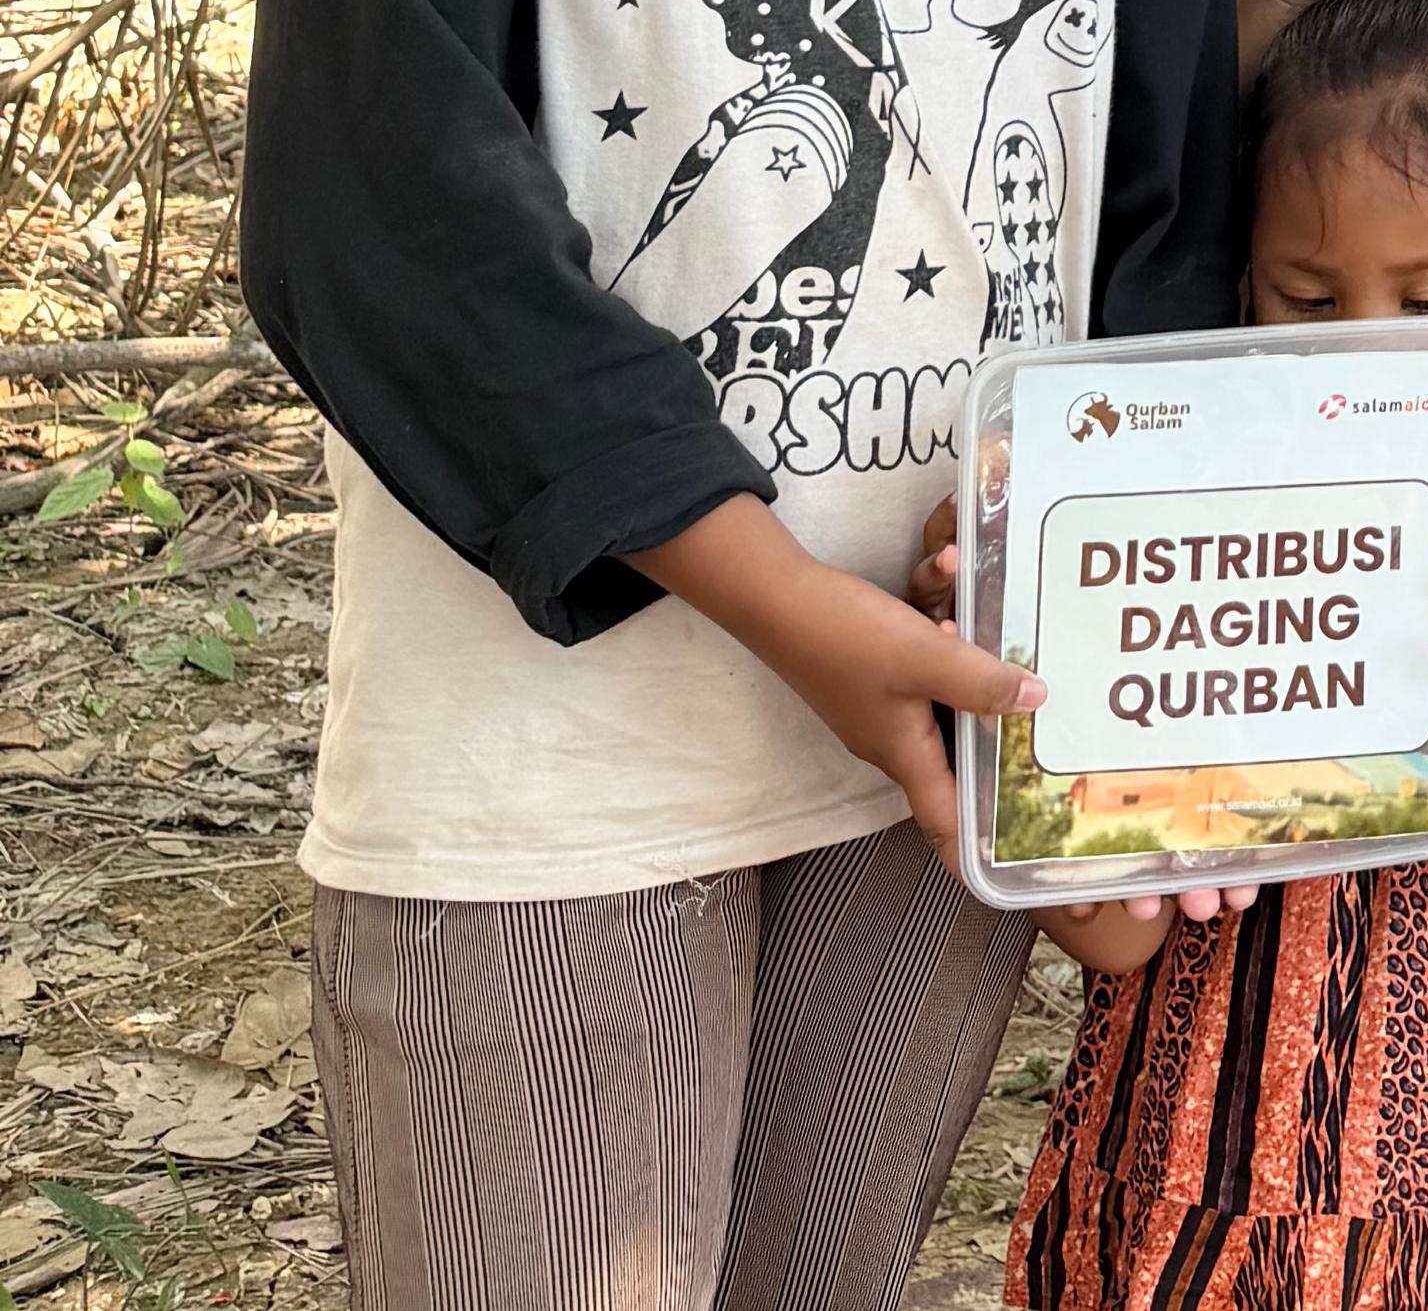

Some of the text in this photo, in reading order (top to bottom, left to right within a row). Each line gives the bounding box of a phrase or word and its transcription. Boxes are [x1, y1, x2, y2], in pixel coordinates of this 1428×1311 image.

[1126, 401, 1191, 419] Qurban
[1130, 415, 1183, 430] Salam
[1079, 525, 1402, 588] DISTRIBUSI
[1119, 594, 1360, 653] DAGING
[1108, 661, 1366, 728] QURBAN
